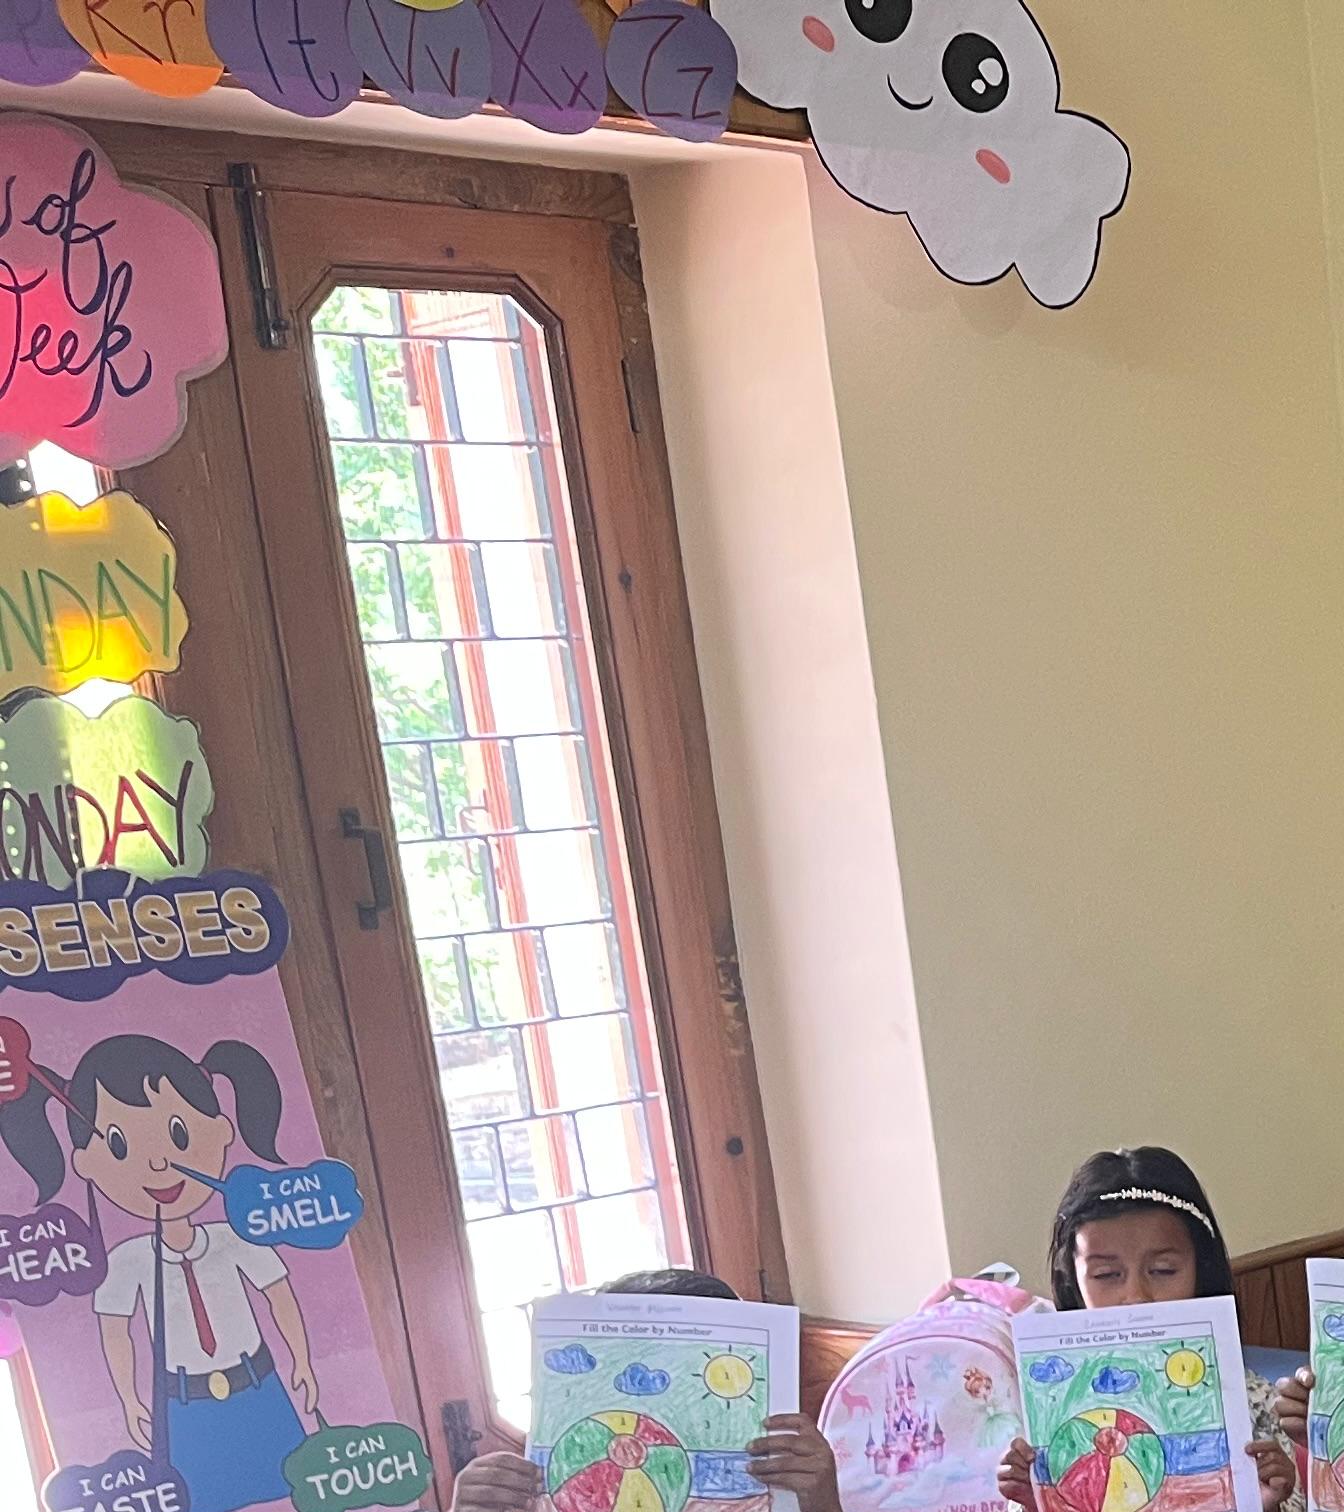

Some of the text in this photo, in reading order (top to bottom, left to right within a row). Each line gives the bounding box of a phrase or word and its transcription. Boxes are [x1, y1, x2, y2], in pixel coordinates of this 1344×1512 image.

[21, 148, 117, 316] of
[0, 887, 270, 976] SENSES
[260, 1174, 321, 1199] I CAN
[19, 1218, 67, 1242] CAN
[247, 1194, 352, 1236] SMELL
[326, 1435, 386, 1464] I CAN
[79, 1465, 146, 1496] I CAN
[305, 1450, 418, 1500] TOUCH
